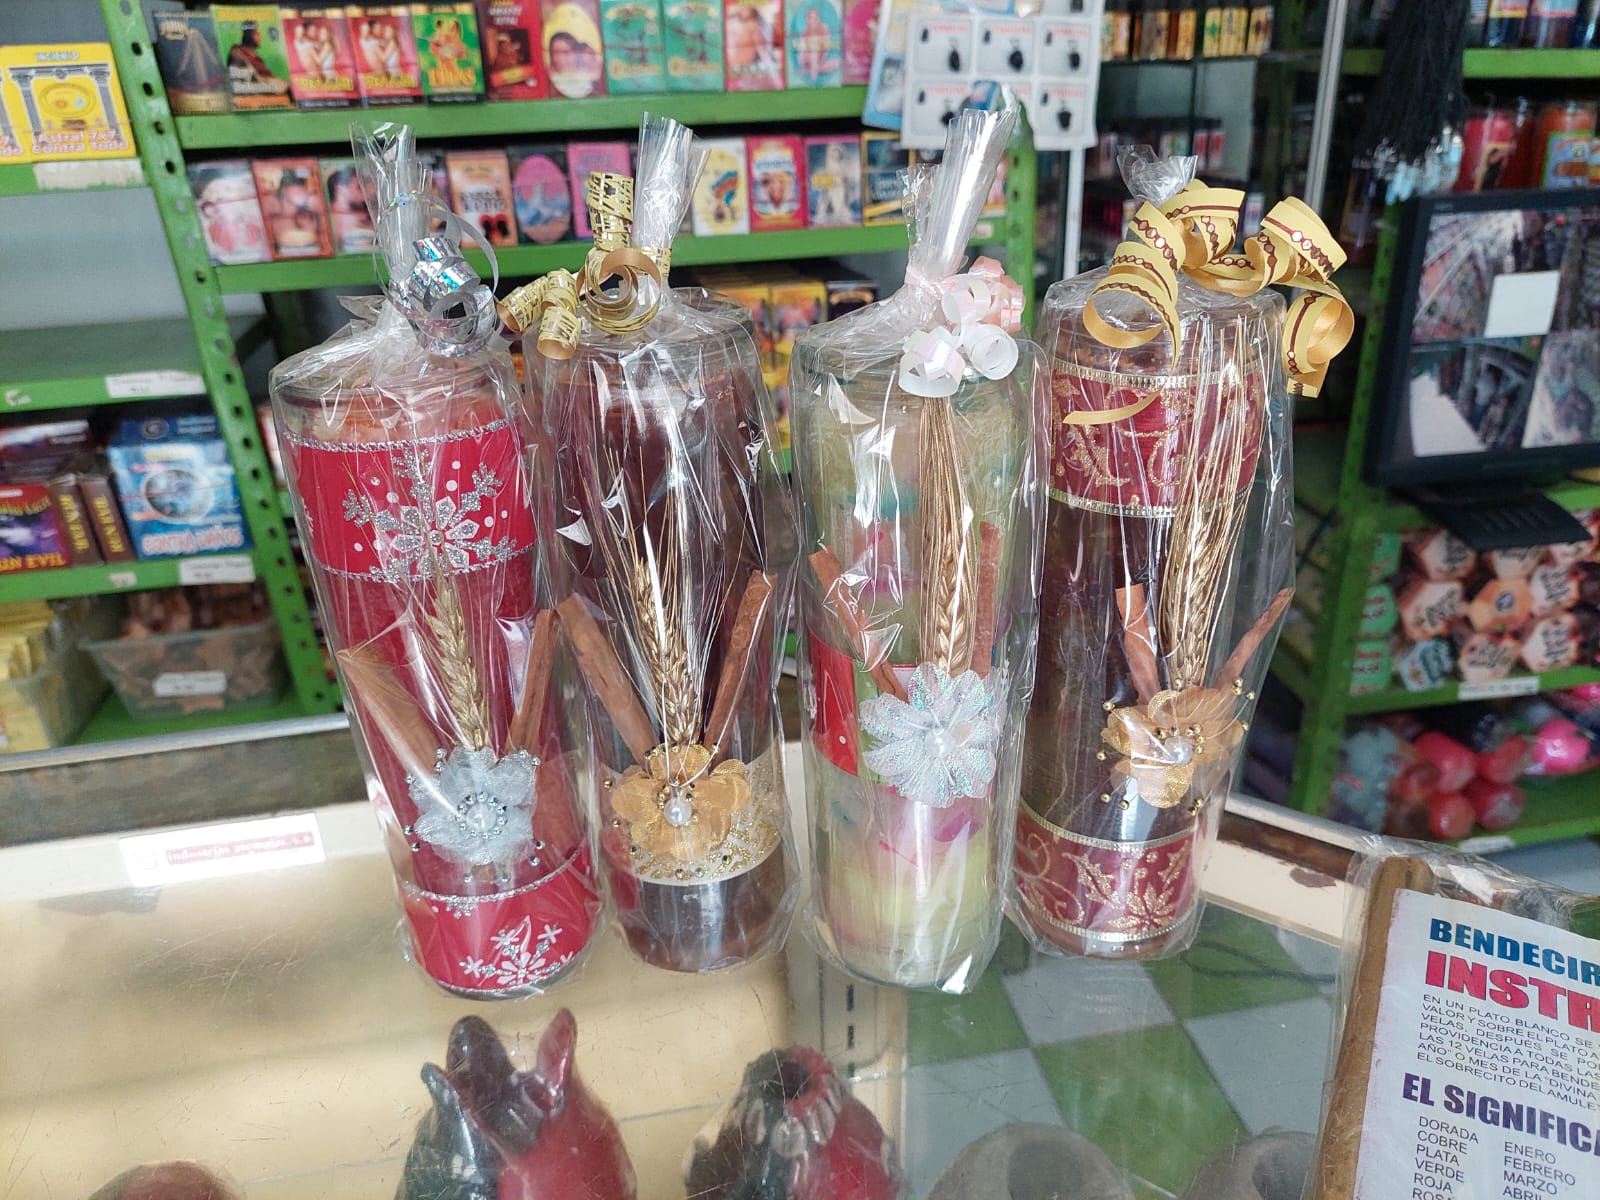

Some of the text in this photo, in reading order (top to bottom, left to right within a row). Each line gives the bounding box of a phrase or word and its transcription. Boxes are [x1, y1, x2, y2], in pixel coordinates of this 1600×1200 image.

[25, 553, 65, 568] EVIL
[1430, 918, 1600, 987] BENDECIR
[1421, 1013, 1468, 1032] VELAS.
[1550, 1048, 1568, 1060] SE
[1422, 1003, 1465, 1020] VALOR
[1467, 1016, 1475, 1024] Y
[1478, 1020, 1524, 1037] SOBRE
[1527, 1031, 1543, 1042] EL
[1545, 1036, 1588, 1057] PLATO
[1423, 994, 1441, 1004] EN
[1446, 999, 1463, 1010] UN
[1469, 1006, 1510, 1024] PLATO
[1515, 1019, 1570, 1041] BLANCO
[1574, 1037, 1593, 1049] SE
[1419, 1032, 1444, 1045] LAS
[1449, 1040, 1462, 1050] 12
[1465, 1046, 1509, 1064] VELAS
[1512, 1058, 1549, 1075] PARA
[1420, 1022, 1512, 1054] PROVIDENCIA
[1514, 1048, 1524, 1056] A
[1526, 1050, 1573, 1072] TODAS
[1417, 1052, 1433, 1063] EL
[1435, 1057, 1516, 1086] SOBRECITO
[1455, 1052, 1465, 1061] O
[1469, 1056, 1498, 1071] MES
[1502, 1065, 1521, 1077] DE
[1525, 1070, 1542, 1082] LA
[1402, 1072, 1435, 1107] EL
[1417, 1130, 1468, 1155] COBRE
[1418, 1115, 1479, 1145] DORADA
[1416, 1143, 1460, 1167] PLATA
[1504, 1141, 1557, 1165] ENERO
[1413, 1172, 1453, 1195] ROJA
[1415, 1158, 1465, 1184] VERDE
[1503, 1170, 1558, 1196] MARZO
[1504, 1155, 1576, 1186] FEBRERO
